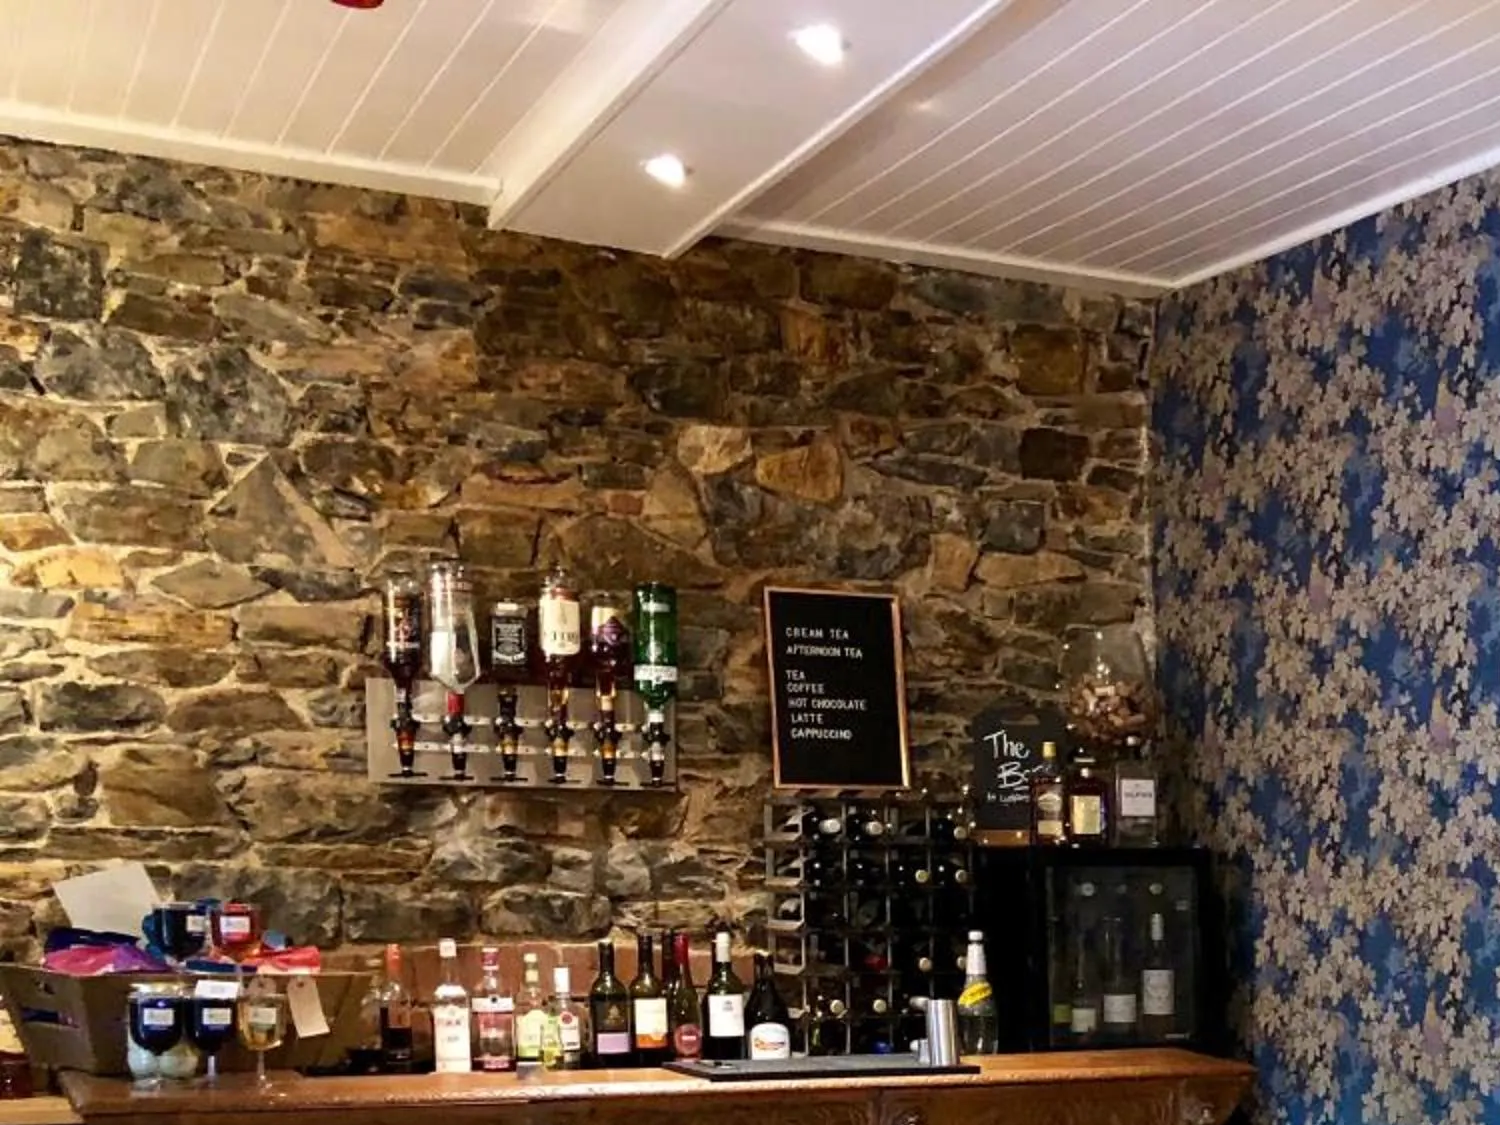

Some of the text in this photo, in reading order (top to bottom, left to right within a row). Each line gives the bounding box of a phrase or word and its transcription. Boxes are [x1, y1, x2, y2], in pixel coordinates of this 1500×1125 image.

[785, 627, 849, 640] CREAM TEA
[786, 644, 863, 660] AFTERNOON TEA
[785, 669, 805, 681] TEA
[786, 682, 825, 694] COFFEE
[788, 697, 867, 711] HOT CHOCOLATE
[791, 713, 824, 724] LATTE
[791, 728, 853, 740] CAPPUCCINO
[983, 729, 1031, 759] The
